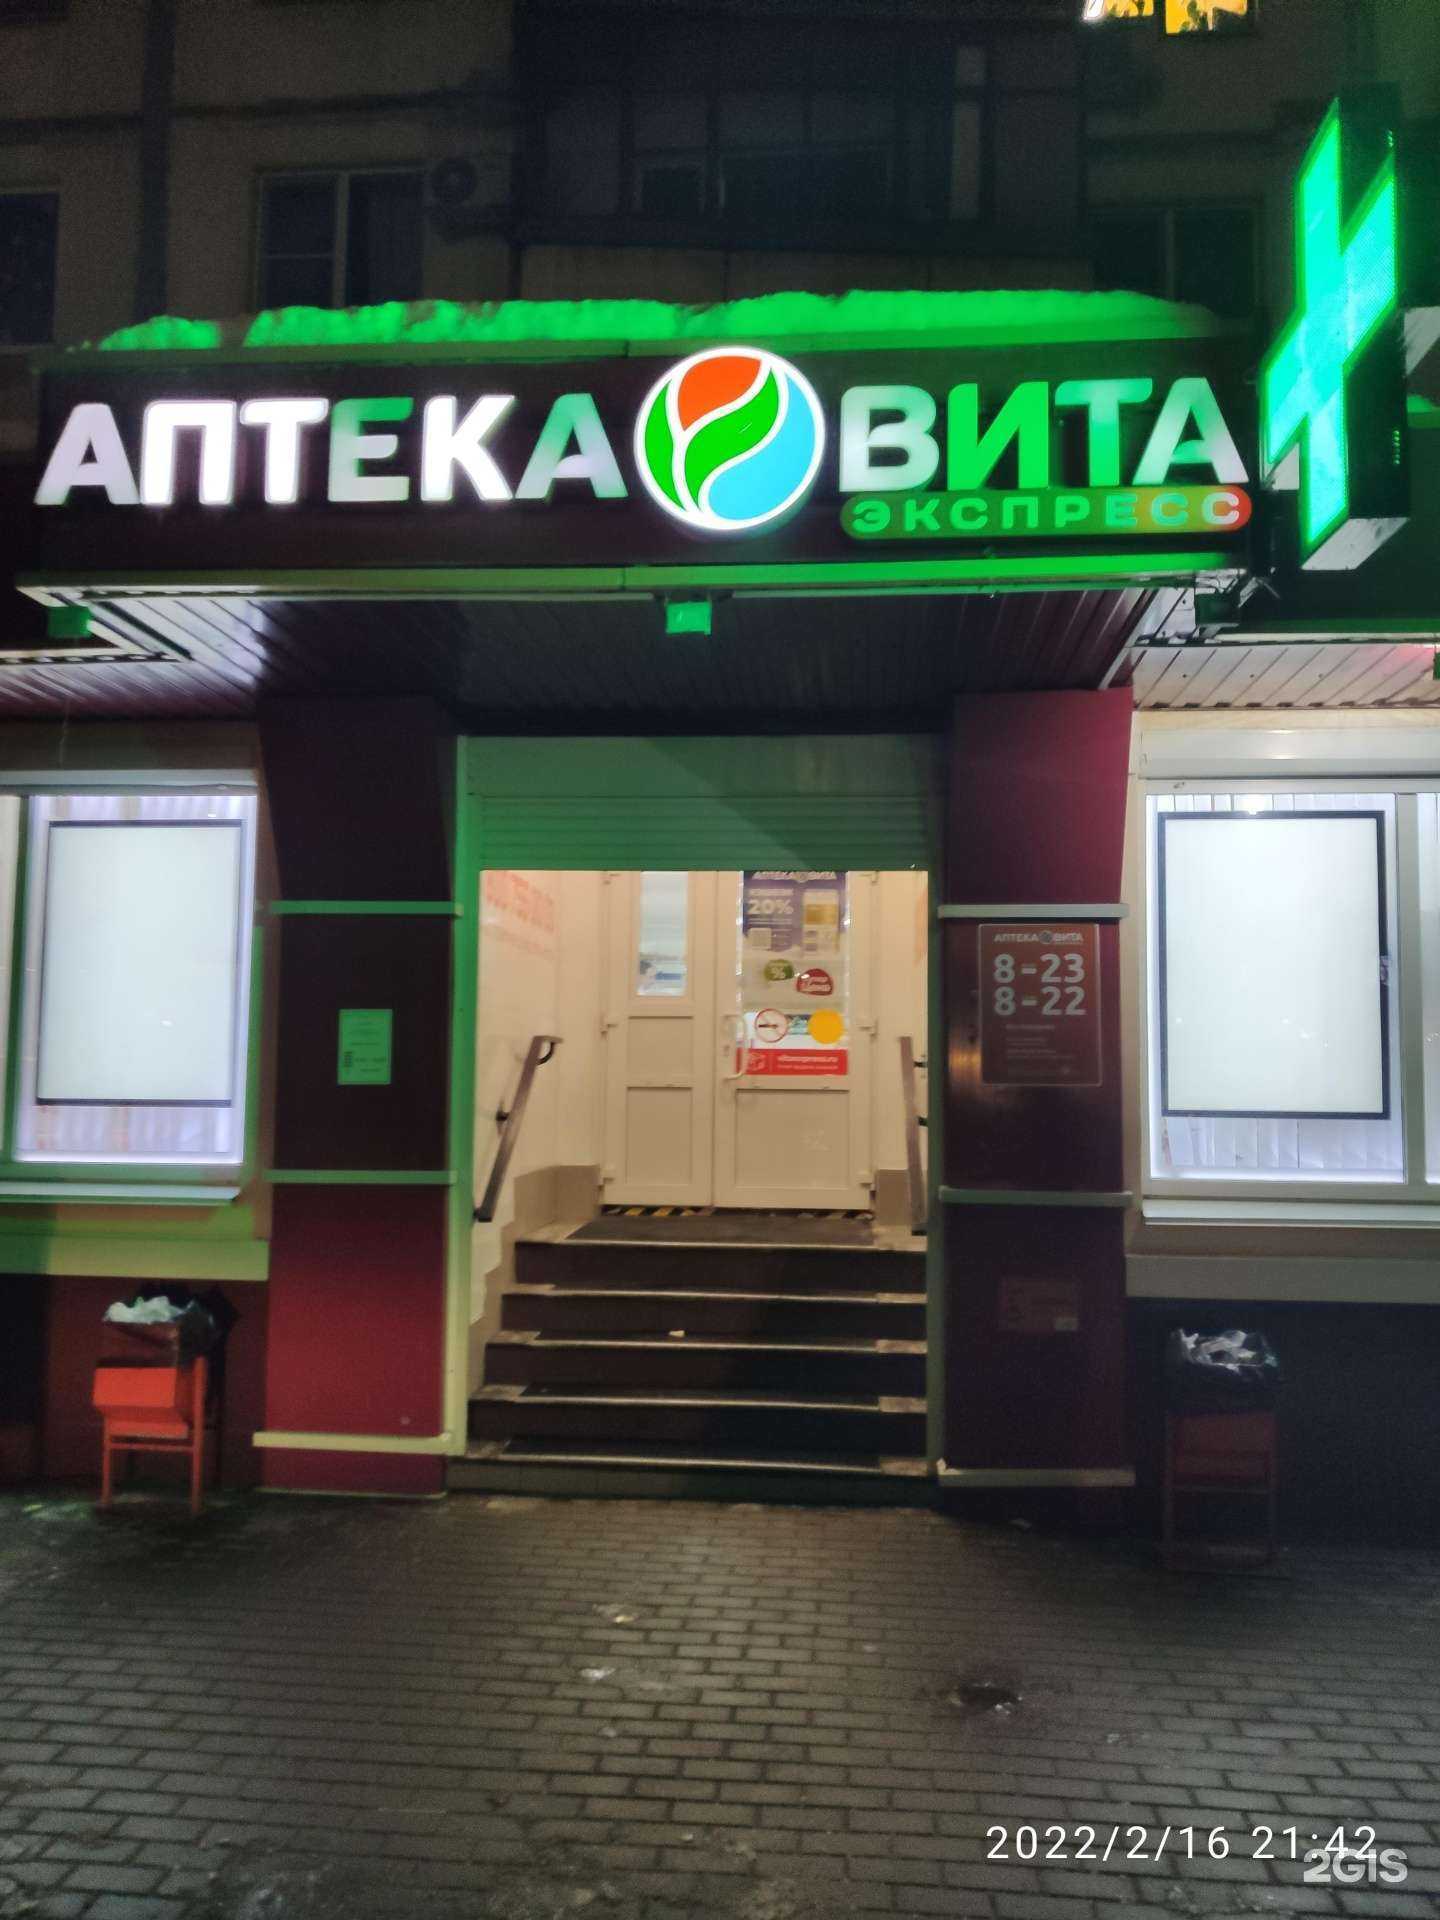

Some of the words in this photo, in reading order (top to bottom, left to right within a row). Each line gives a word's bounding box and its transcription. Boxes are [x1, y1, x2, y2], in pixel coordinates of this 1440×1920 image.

[34, 393, 628, 505] АПТЕКА
[839, 377, 1249, 492] ВИТА
[851, 493, 1241, 533] ЭКСПРЕСС
[748, 899, 794, 915] 20%
[994, 932, 1039, 942] АПТЕКА
